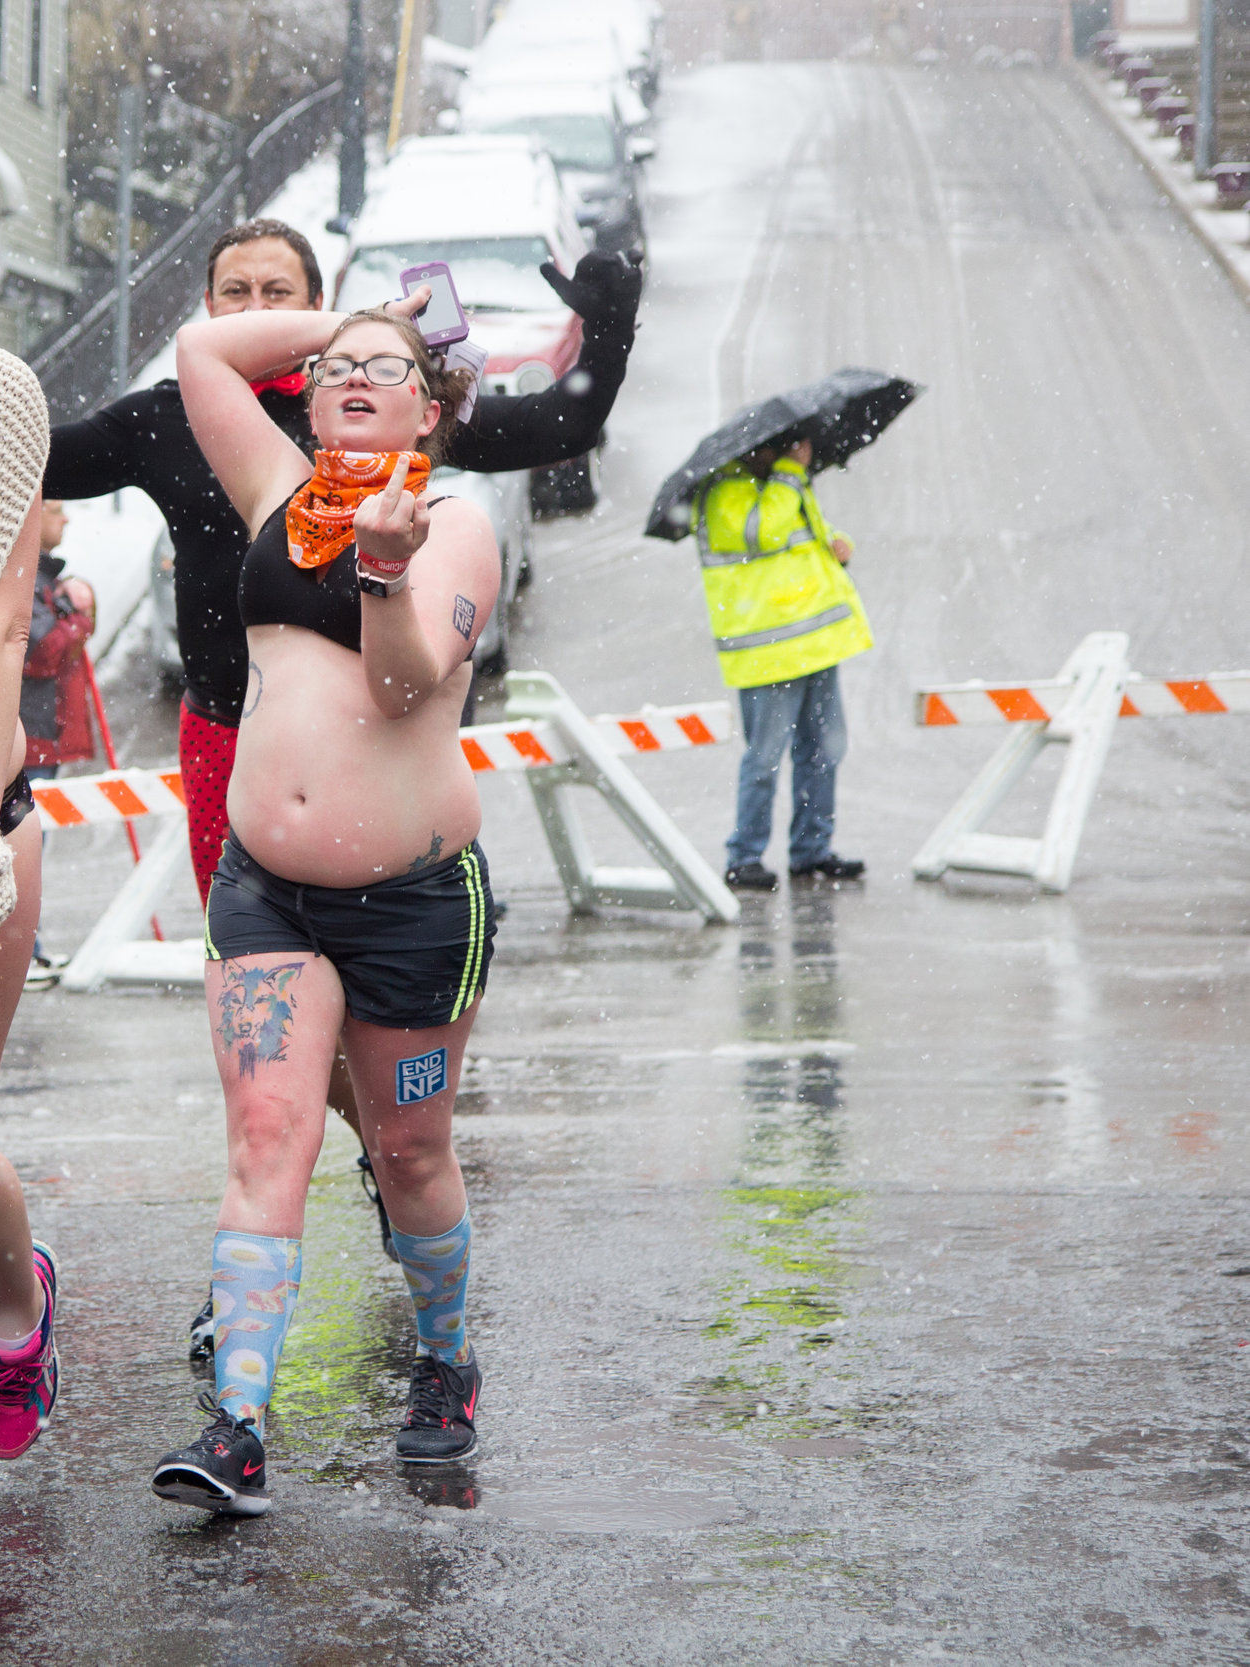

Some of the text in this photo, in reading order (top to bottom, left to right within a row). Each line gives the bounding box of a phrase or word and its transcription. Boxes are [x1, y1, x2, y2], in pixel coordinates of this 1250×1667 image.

[456, 596, 473, 616] END
[455, 611, 472, 634] NF
[402, 1053, 442, 1076] END
[403, 1069, 443, 1101] NF
